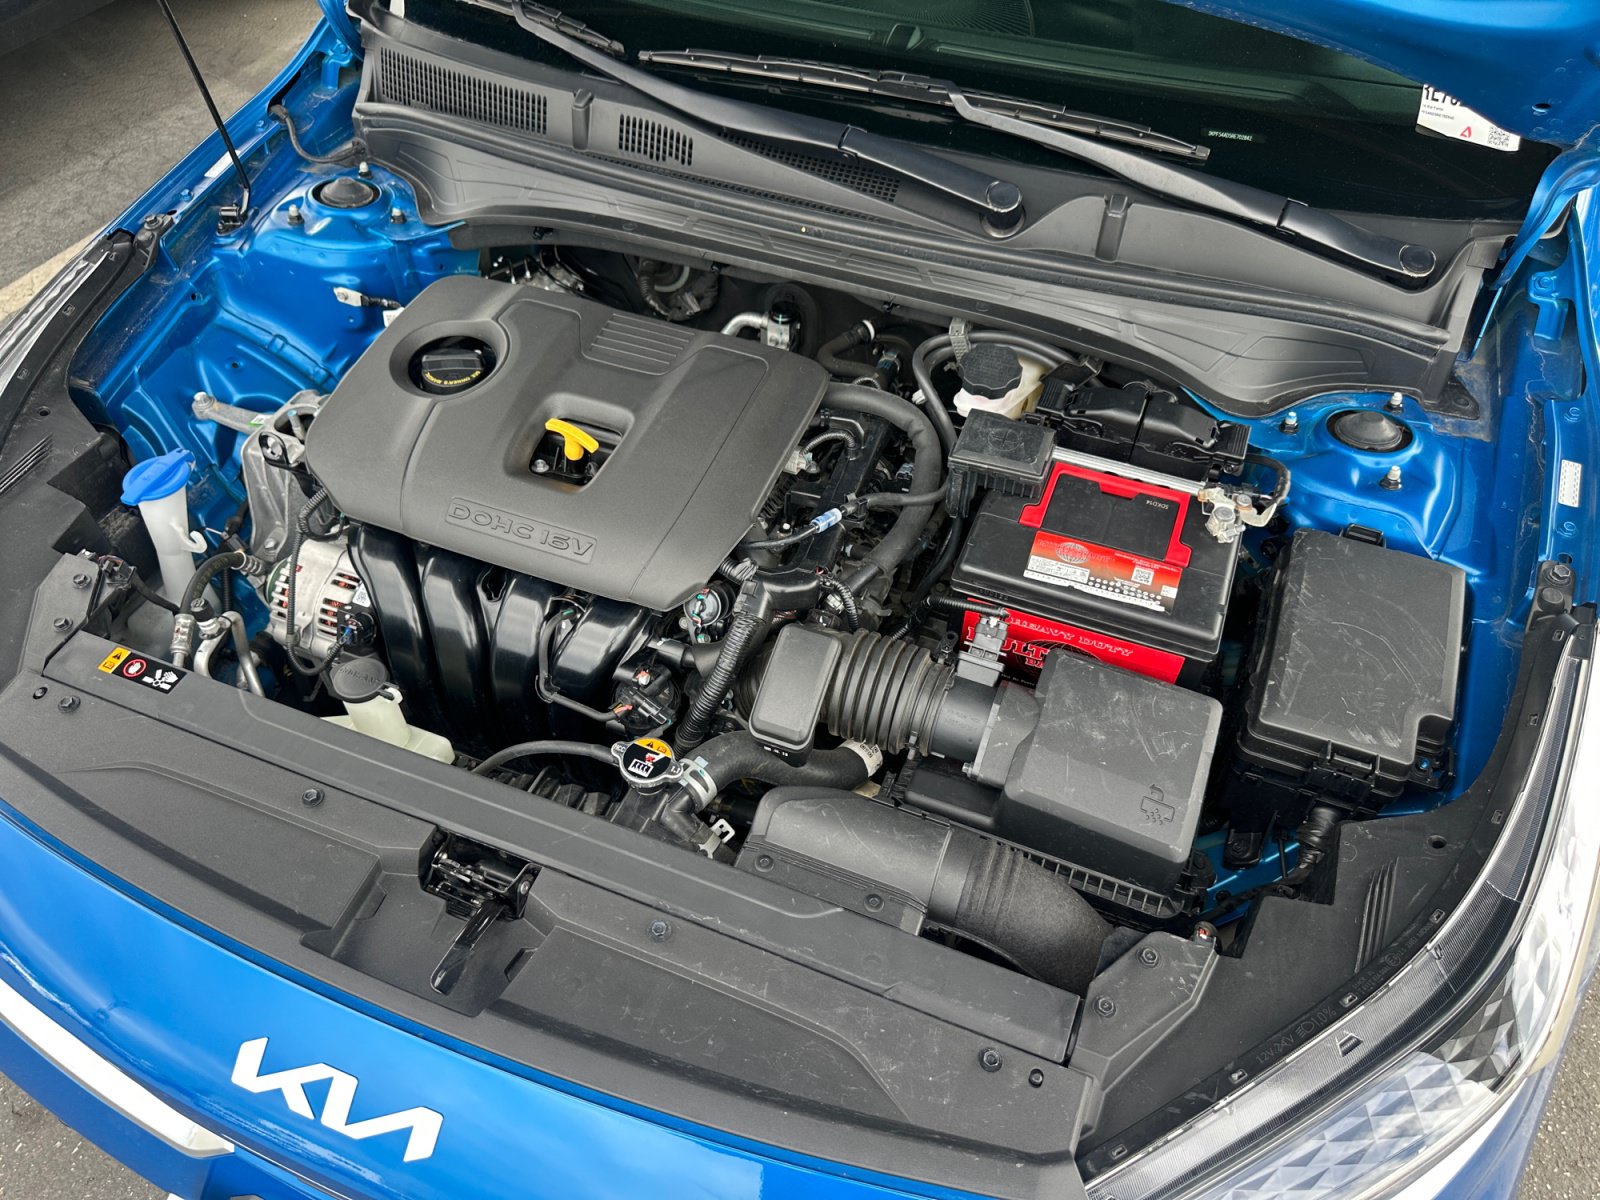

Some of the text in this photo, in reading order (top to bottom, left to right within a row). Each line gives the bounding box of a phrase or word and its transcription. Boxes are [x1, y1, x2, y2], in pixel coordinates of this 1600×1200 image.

[448, 502, 594, 556] DOHC 16V
[1078, 635, 1134, 657] DUTY
[230, 1036, 445, 1164] KIA
